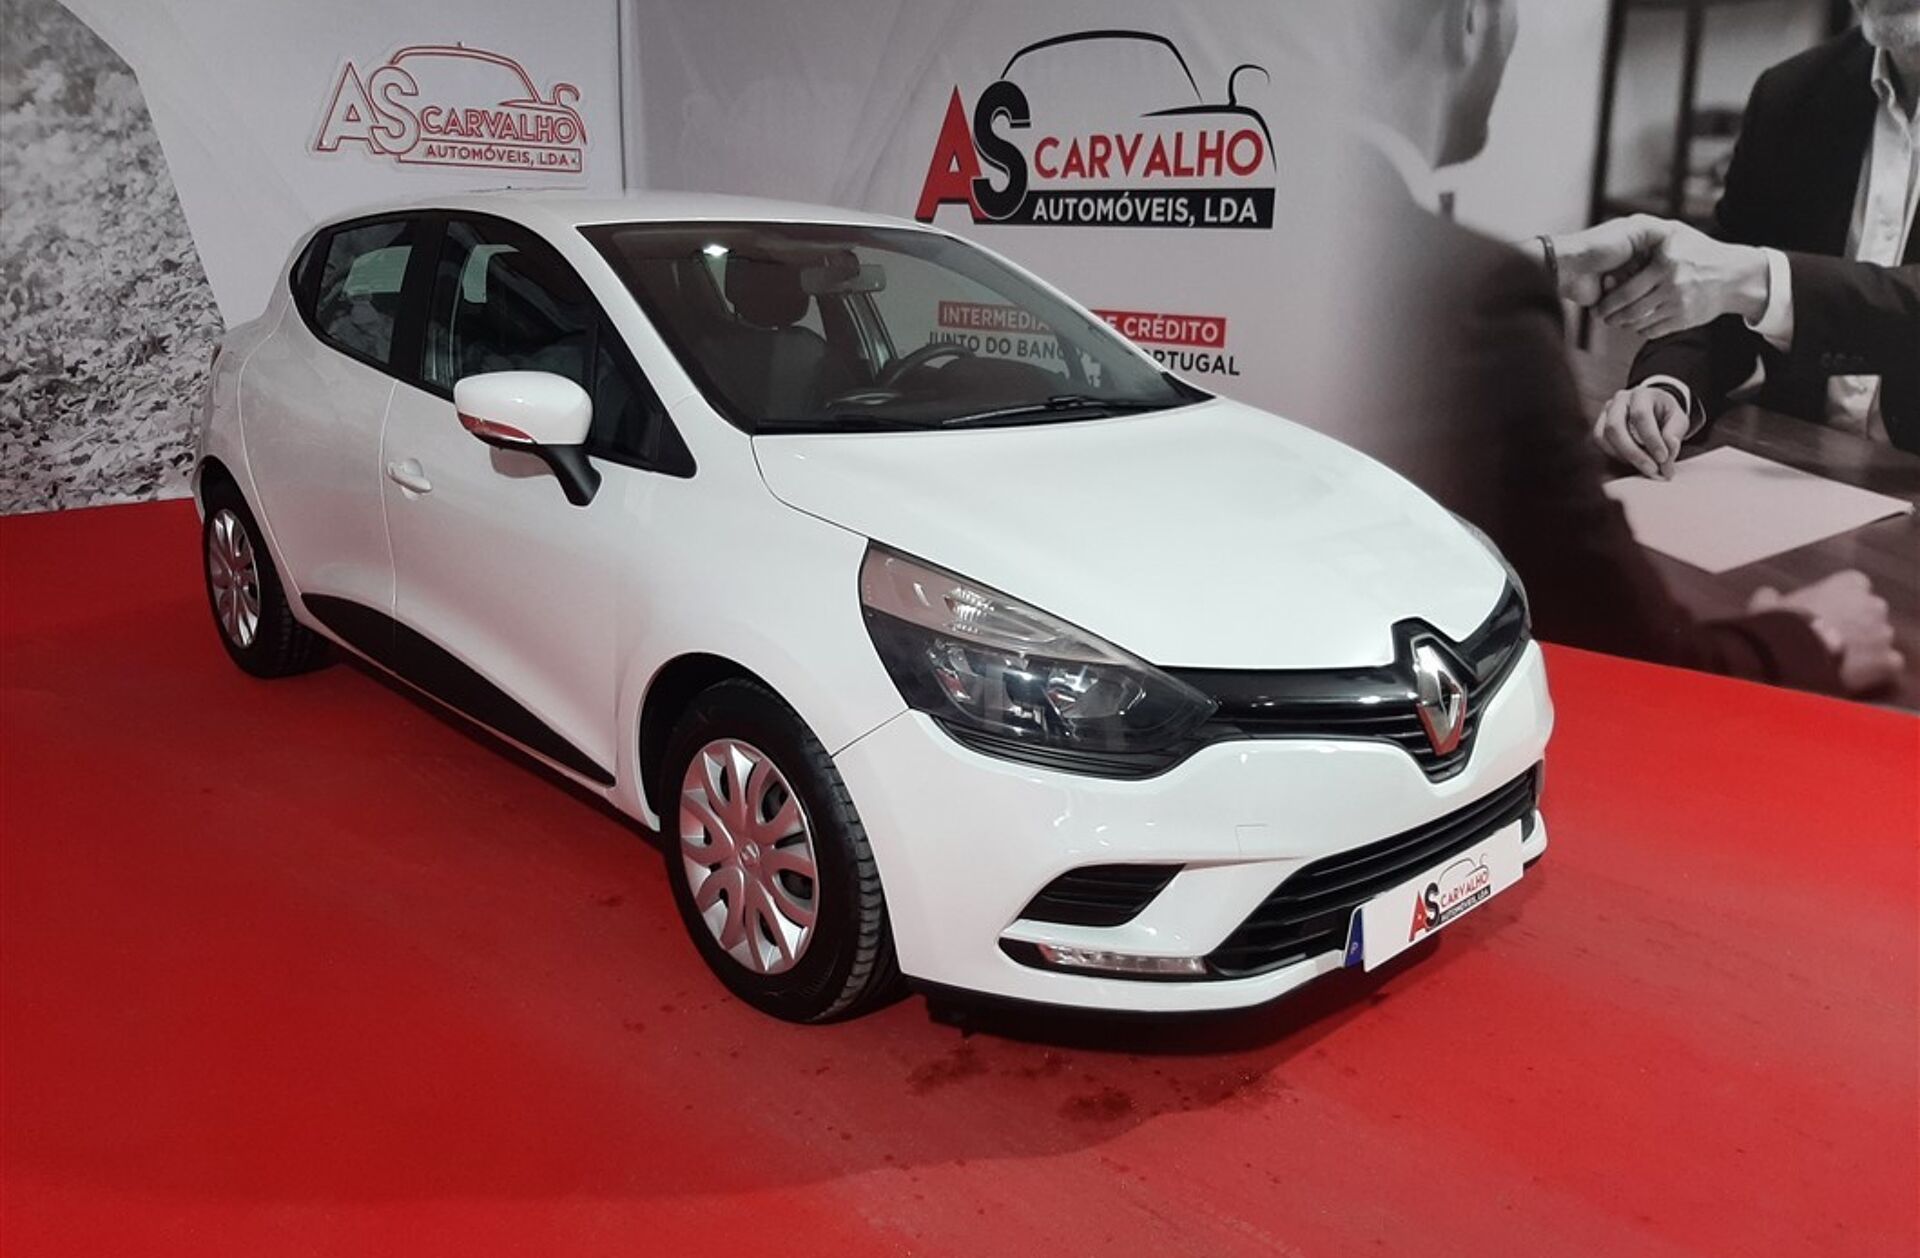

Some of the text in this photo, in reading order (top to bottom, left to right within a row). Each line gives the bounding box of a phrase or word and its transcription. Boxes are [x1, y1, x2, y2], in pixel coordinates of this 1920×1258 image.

[316, 61, 578, 154] AS CARVALHO
[426, 145, 569, 167] AUTOMÓVEIS, LDA
[915, 80, 1265, 223] AS CARVALHO
[1032, 191, 1258, 227] AUTOMÓVEIS, LDA
[943, 305, 1050, 331] INTERMEDIA
[1123, 313, 1219, 342] CRÉDITO
[986, 337, 1011, 354] DO
[1017, 340, 1066, 359] BANC
[1143, 349, 1240, 376] RTUGAL
[1409, 882, 1440, 942] AS
[1440, 870, 1489, 908] CARVALHO
